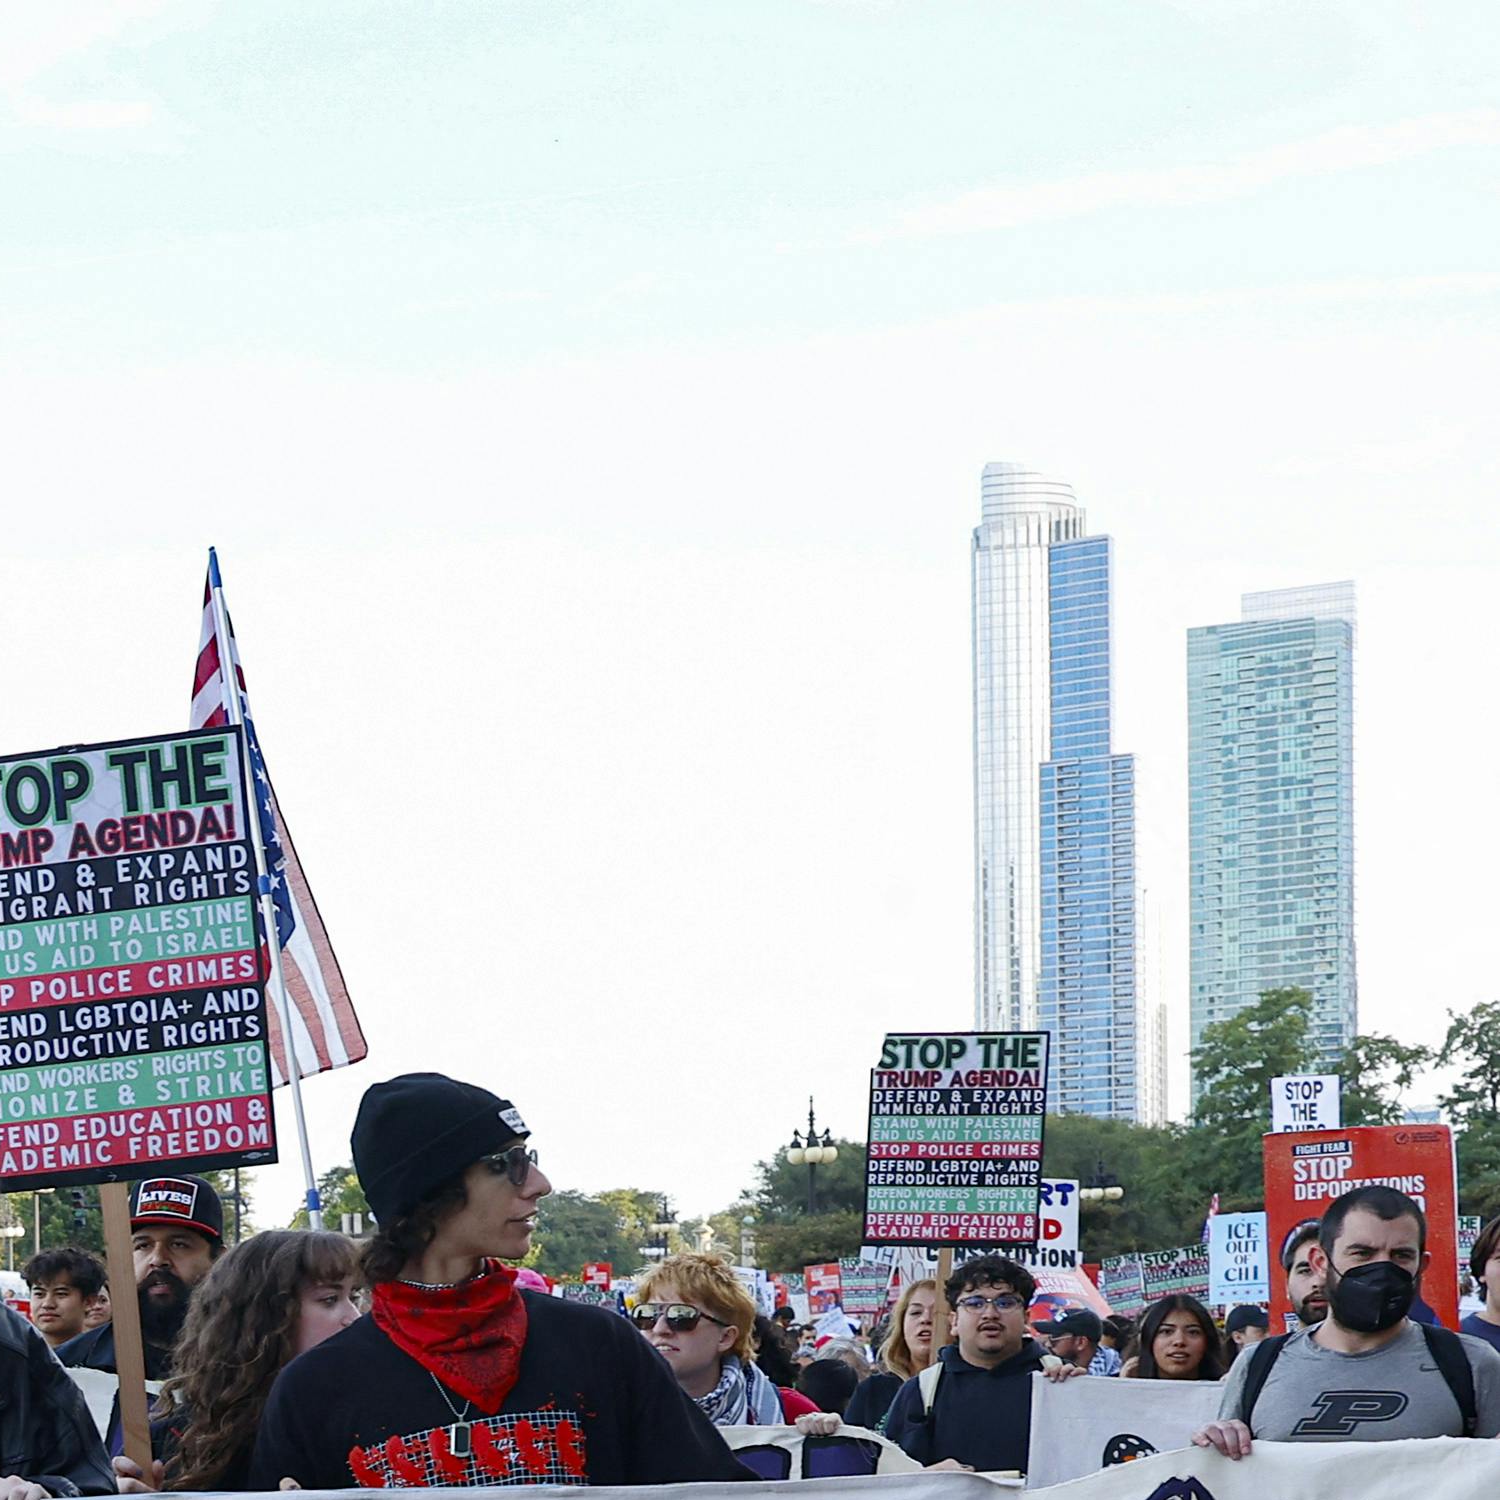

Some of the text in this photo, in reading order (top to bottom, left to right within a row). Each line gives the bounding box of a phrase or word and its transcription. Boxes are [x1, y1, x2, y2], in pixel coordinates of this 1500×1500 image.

[108, 738, 231, 813] THE
[66, 802, 236, 860] AGENDA!
[75, 862, 96, 888] &
[117, 842, 248, 883] EXPAND
[134, 869, 250, 905] RIGHTS
[35, 918, 98, 947] WITH
[109, 899, 247, 938] PALESTINE
[4, 951, 37, 976] US
[50, 944, 95, 970] AID
[109, 938, 143, 963] TO
[156, 924, 249, 957] ISRAEL
[30, 969, 132, 1003] POLICE
[147, 954, 254, 989] CRIMES
[60, 995, 193, 1034] LGBTQIA+
[201, 986, 260, 1016] AND
[162, 1014, 260, 1047] RIGHTS
[879, 1037, 1041, 1070] STOP THE
[38, 1058, 145, 1090] WORKERS'
[152, 1049, 226, 1077] RIGHTS
[234, 1044, 262, 1067] TO
[117, 1083, 136, 1106] &
[156, 1067, 264, 1102] STRIKE
[874, 1069, 1040, 1088] TRUMP AGENDA!
[873, 1089, 1044, 1102] DEFEND & EXPAND
[1285, 1081, 1323, 1100] STOP
[872, 1103, 1043, 1114] IMMIGRANT RIGHTS
[1291, 1103, 1317, 1122] THE
[73, 1101, 233, 1141] EDUCATION
[246, 1097, 266, 1121] &
[872, 1117, 1039, 1128] STAND WITH PALESTINE
[129, 1122, 268, 1159] FREEDOM
[872, 1130, 1038, 1140] END US AID TO ISRAEL
[870, 1144, 1039, 1155] STOP POLICE CRIMES
[1296, 1141, 1347, 1155] FIGHT FEAR
[869, 1161, 1039, 1172] DEFEND LGBTQIA+ AND
[1293, 1157, 1352, 1182] STOP
[868, 1174, 1037, 1185] REPRODUCTIVE RIGHTS
[141, 1190, 192, 1205] LIVES
[868, 1188, 1036, 1199] DEFEND WORKERS' RIGHTS TO
[867, 1200, 1035, 1211] UNIONIZE & STRIKE
[866, 1214, 1034, 1226] DEFEND EDUCATION &
[866, 1226, 1034, 1238] ACADEMIC FREEDOM
[1227, 1222, 1259, 1239] ICE
[1144, 1244, 1209, 1267] STOP THE
[1226, 1240, 1260, 1254] OUT
[1234, 1254, 1250, 1264] OF
[1224, 1265, 1258, 1282] CHI
[1290, 1390, 1409, 1436] P
